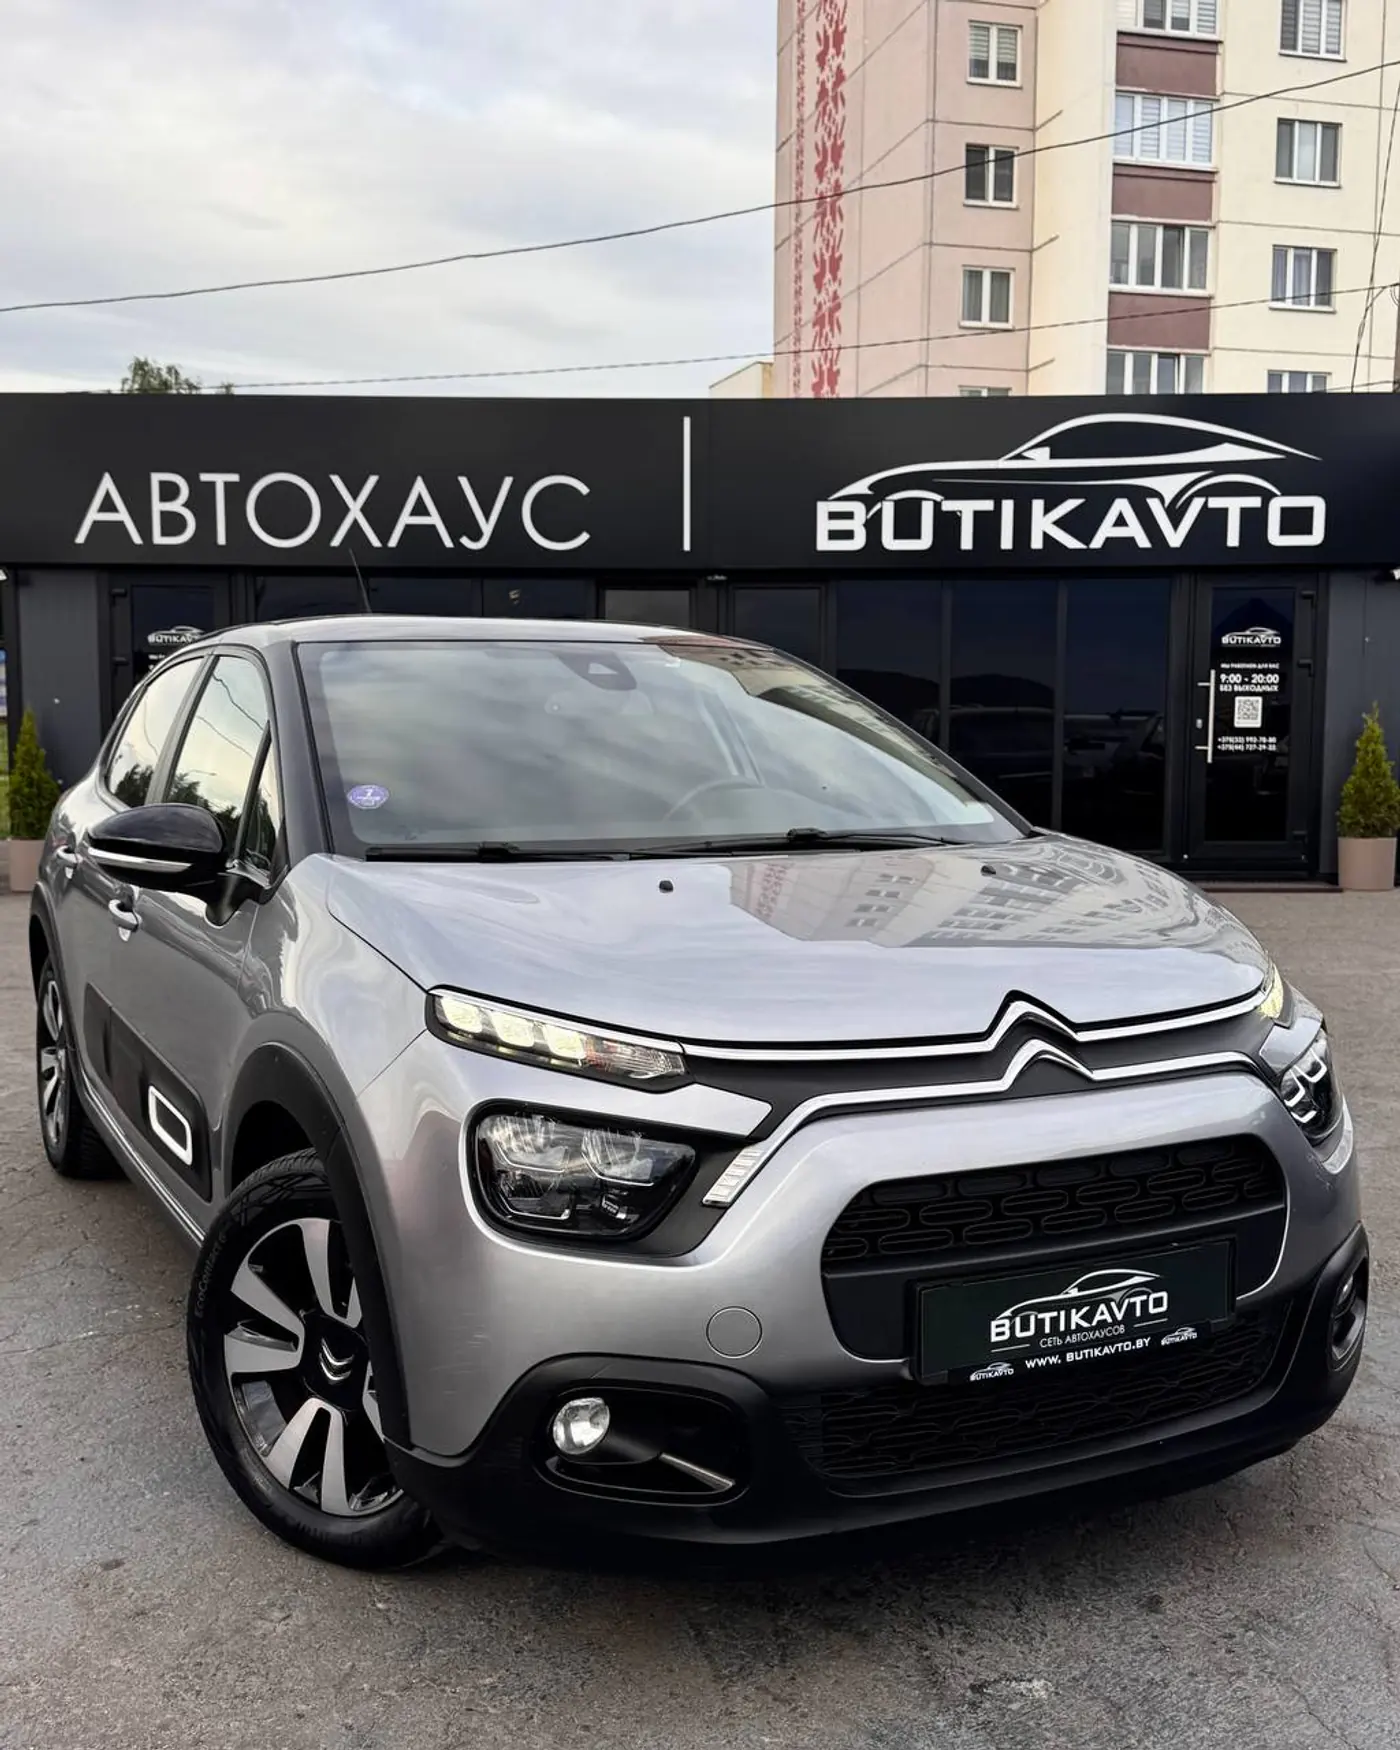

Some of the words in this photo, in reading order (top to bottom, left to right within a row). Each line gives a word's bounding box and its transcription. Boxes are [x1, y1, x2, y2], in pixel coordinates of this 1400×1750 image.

[74, 472, 591, 552] АВТОХАУС
[815, 494, 1326, 552] BUTIKAVTO
[1221, 635, 1281, 644] BUTIKAVTO
[1220, 673, 1242, 684] 9:00
[1251, 673, 1280, 684] 20:00
[1220, 684, 1232, 692] БЕЗ
[1233, 684, 1279, 692] ВЫХОДНЫХ
[990, 1291, 1168, 1343] BUTIKAVTO
[1039, 1336, 1063, 1348] СЕТЬ
[1064, 1324, 1126, 1345] АВТОХАУСОВ
[1025, 1354, 1061, 1369] WWW.
[1066, 1337, 1151, 1362] BUTIKAVTO.BY
[969, 1368, 1015, 1381] BUTIKAVTO
